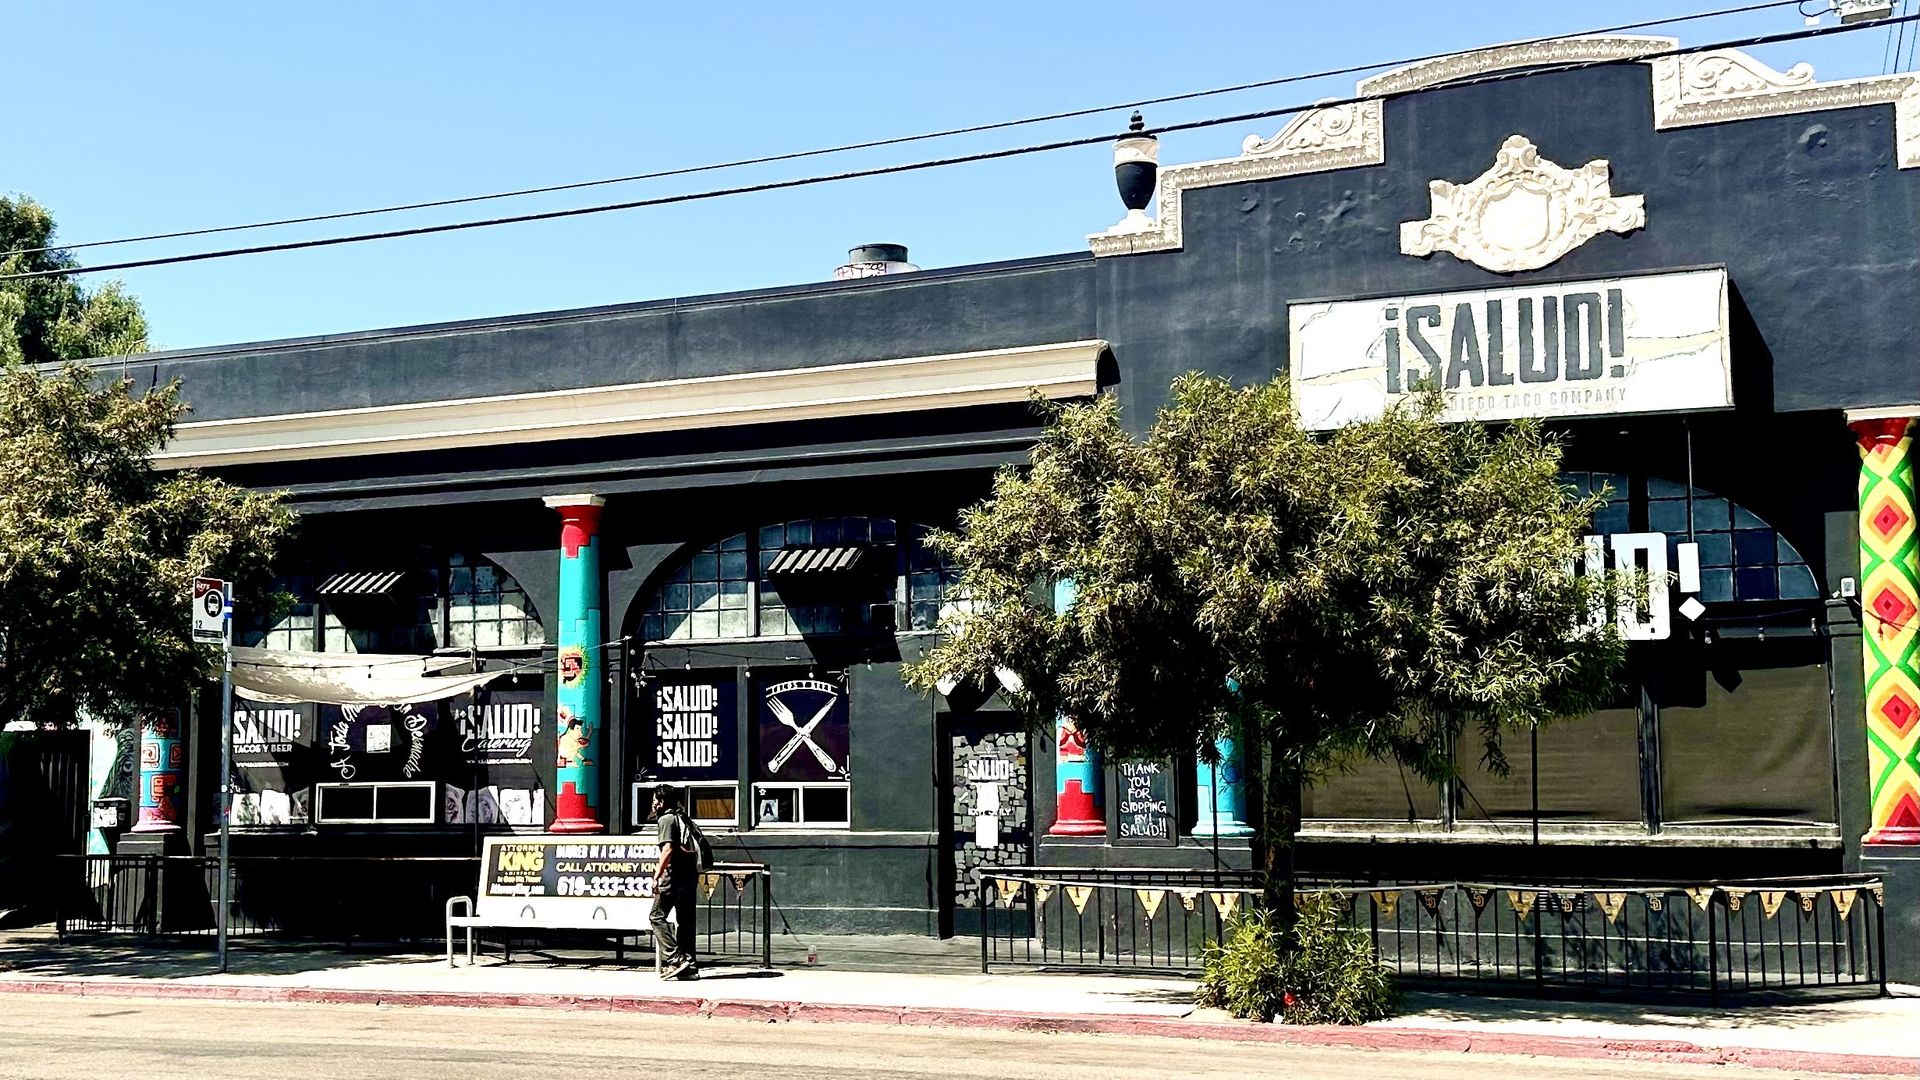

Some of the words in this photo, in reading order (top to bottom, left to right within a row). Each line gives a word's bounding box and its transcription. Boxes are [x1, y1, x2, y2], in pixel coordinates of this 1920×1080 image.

[1385, 288, 1625, 394] ¡SALUD!
[1450, 396, 1495, 411] DIEGO
[1504, 393, 1541, 408] TACO
[1550, 388, 1627, 405] COMPANY
[195, 620, 203, 628] 12
[657, 685, 718, 712] ¡SALUD!
[657, 713, 718, 739] ¡SALUD!
[233, 744, 262, 753] TACOS
[262, 744, 269, 753] Y
[271, 744, 292, 753] BEER
[657, 741, 718, 768] ¡SALUD!
[1121, 762, 1160, 776] THANK
[1128, 776, 1150, 789] YOU
[1128, 788, 1152, 803] FOR
[763, 803, 774, 816] A
[498, 851, 544, 871] KING
[556, 862, 582, 872] CALL
[584, 862, 639, 872] ATTORNEY
[641, 862, 660, 872] KIN
[557, 876, 654, 897] 619-333-333
